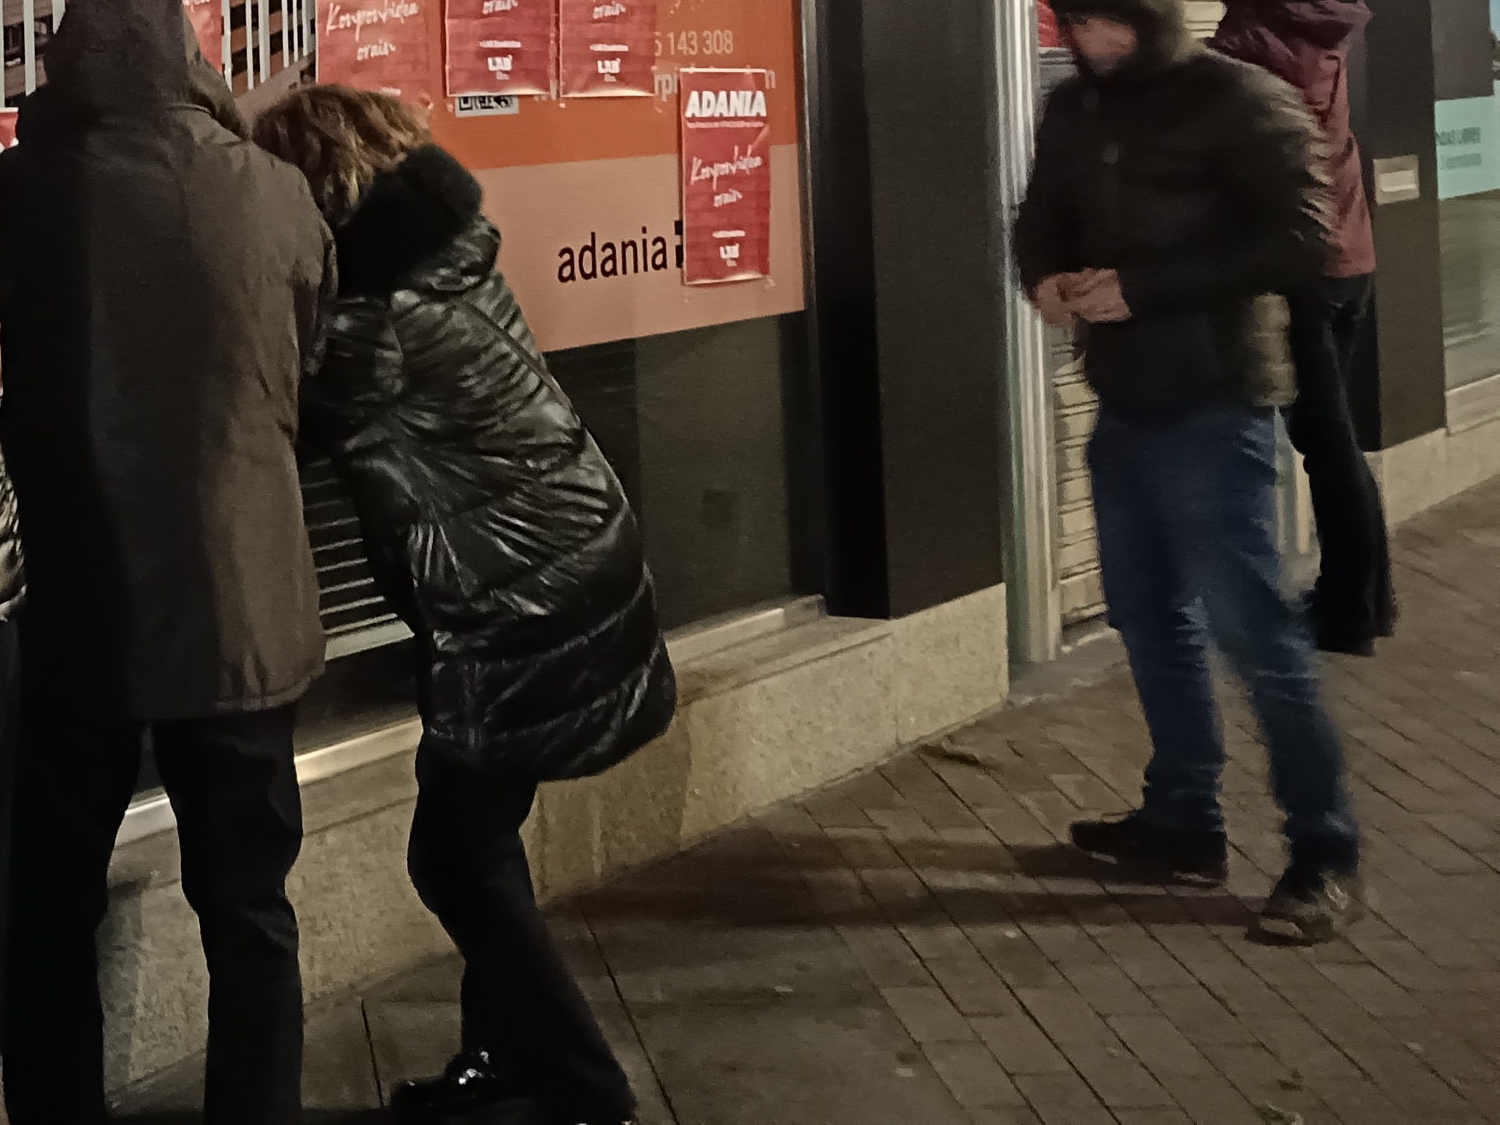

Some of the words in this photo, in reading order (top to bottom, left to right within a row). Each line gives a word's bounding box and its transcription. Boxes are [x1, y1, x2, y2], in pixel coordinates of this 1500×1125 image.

[667, 31, 698, 56] 143
[703, 30, 734, 55] 308
[685, 90, 767, 118] ADANIA
[557, 225, 668, 283] adania
